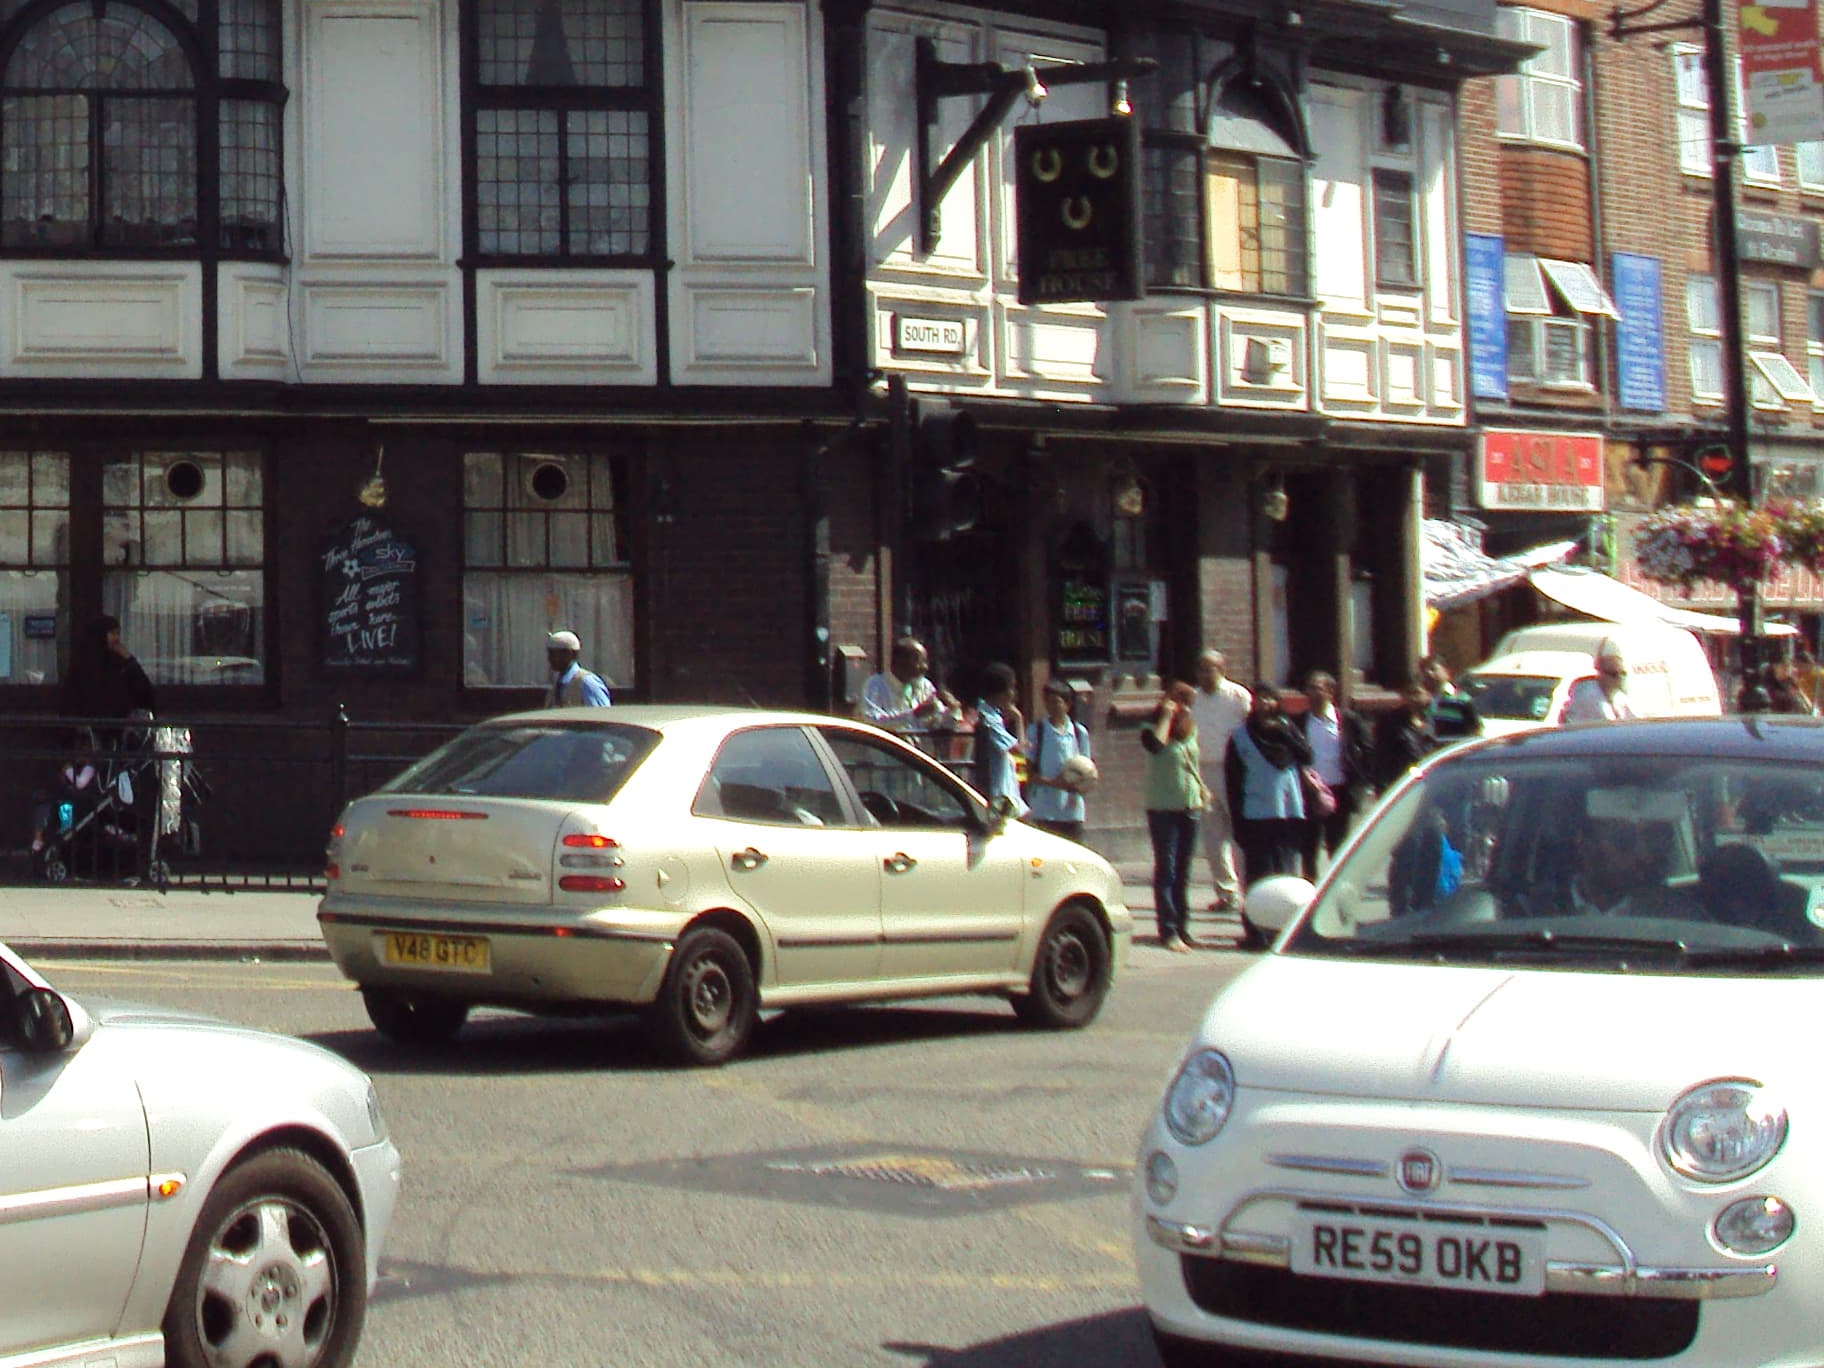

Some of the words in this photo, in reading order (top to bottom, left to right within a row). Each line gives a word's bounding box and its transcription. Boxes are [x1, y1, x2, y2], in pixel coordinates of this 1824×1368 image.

[904, 325, 940, 344] SOUTH
[943, 327, 961, 345] RD.
[1313, 1223, 1423, 1275] RE59
[1436, 1238, 1522, 1285] OKB
